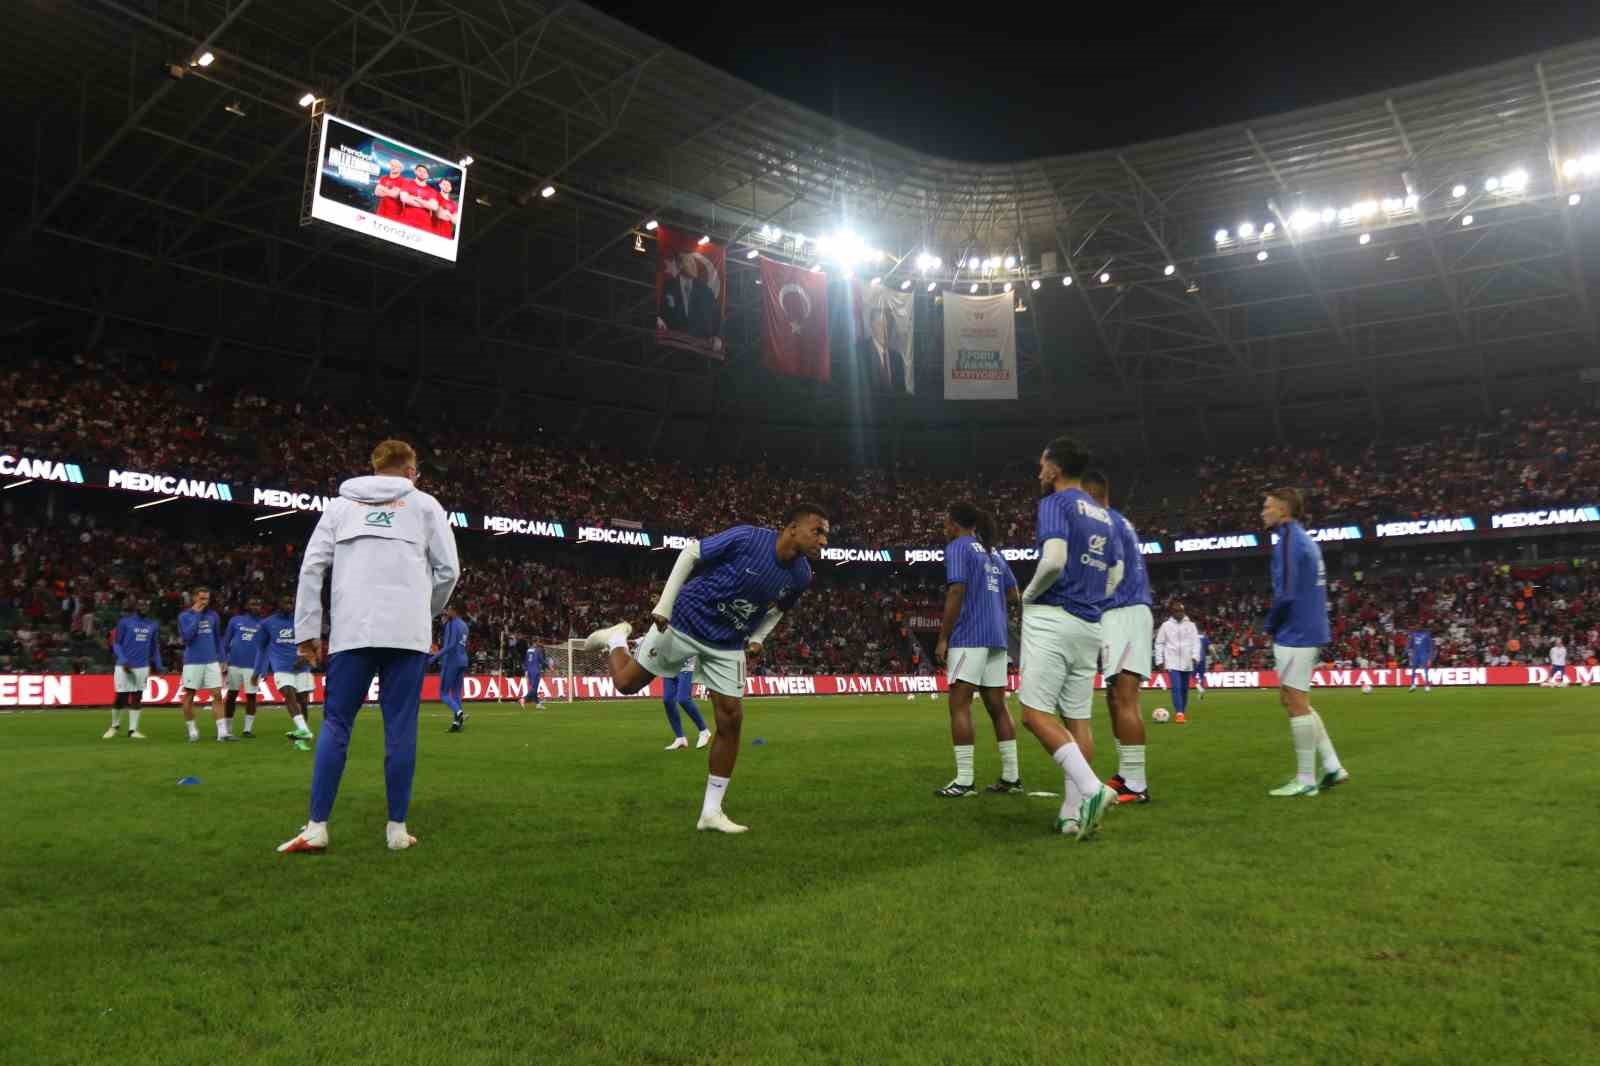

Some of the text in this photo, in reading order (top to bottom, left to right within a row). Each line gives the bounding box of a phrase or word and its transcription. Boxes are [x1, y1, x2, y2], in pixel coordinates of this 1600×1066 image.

[108, 470, 219, 500] MEDICANA
[254, 488, 336, 512] MEDICAN
[484, 516, 556, 537] MEDICANA
[1492, 508, 1587, 529] MEDICANA
[578, 527, 643, 546] MEDICANA
[1376, 518, 1462, 538] MEDICANA
[1174, 534, 1246, 552] MEDICANA
[820, 548, 881, 561] MEDICANA
[905, 550, 945, 562] MEDIC
[765, 676, 815, 694] TWEEN
[836, 676, 937, 693] DAMAT TWEEN
[1196, 671, 1259, 688] WEEN
[1309, 669, 1391, 686] AMAT
[463, 677, 567, 698] DAMAT
